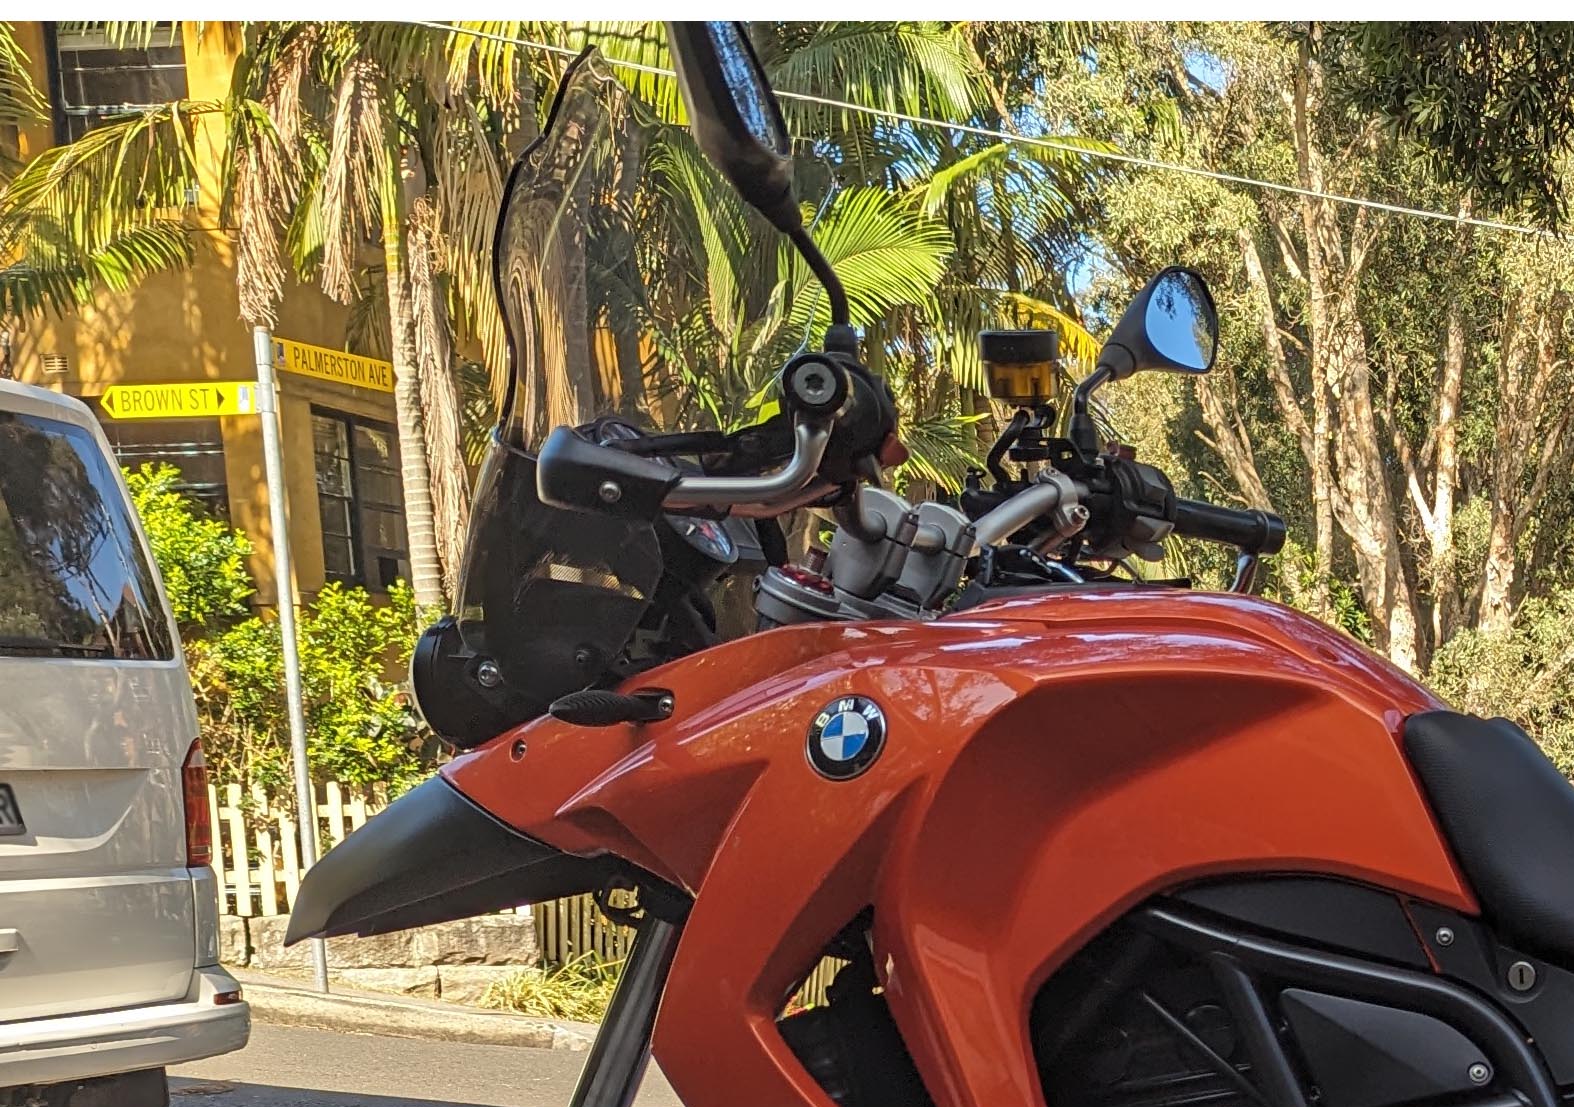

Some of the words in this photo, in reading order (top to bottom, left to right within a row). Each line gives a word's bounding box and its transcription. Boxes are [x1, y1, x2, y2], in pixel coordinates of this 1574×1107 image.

[293, 346, 366, 382] PALMERSTON
[368, 362, 389, 387] AVE
[120, 389, 183, 413] BROWN
[189, 388, 210, 410] ST
[815, 698, 880, 728] BMW
